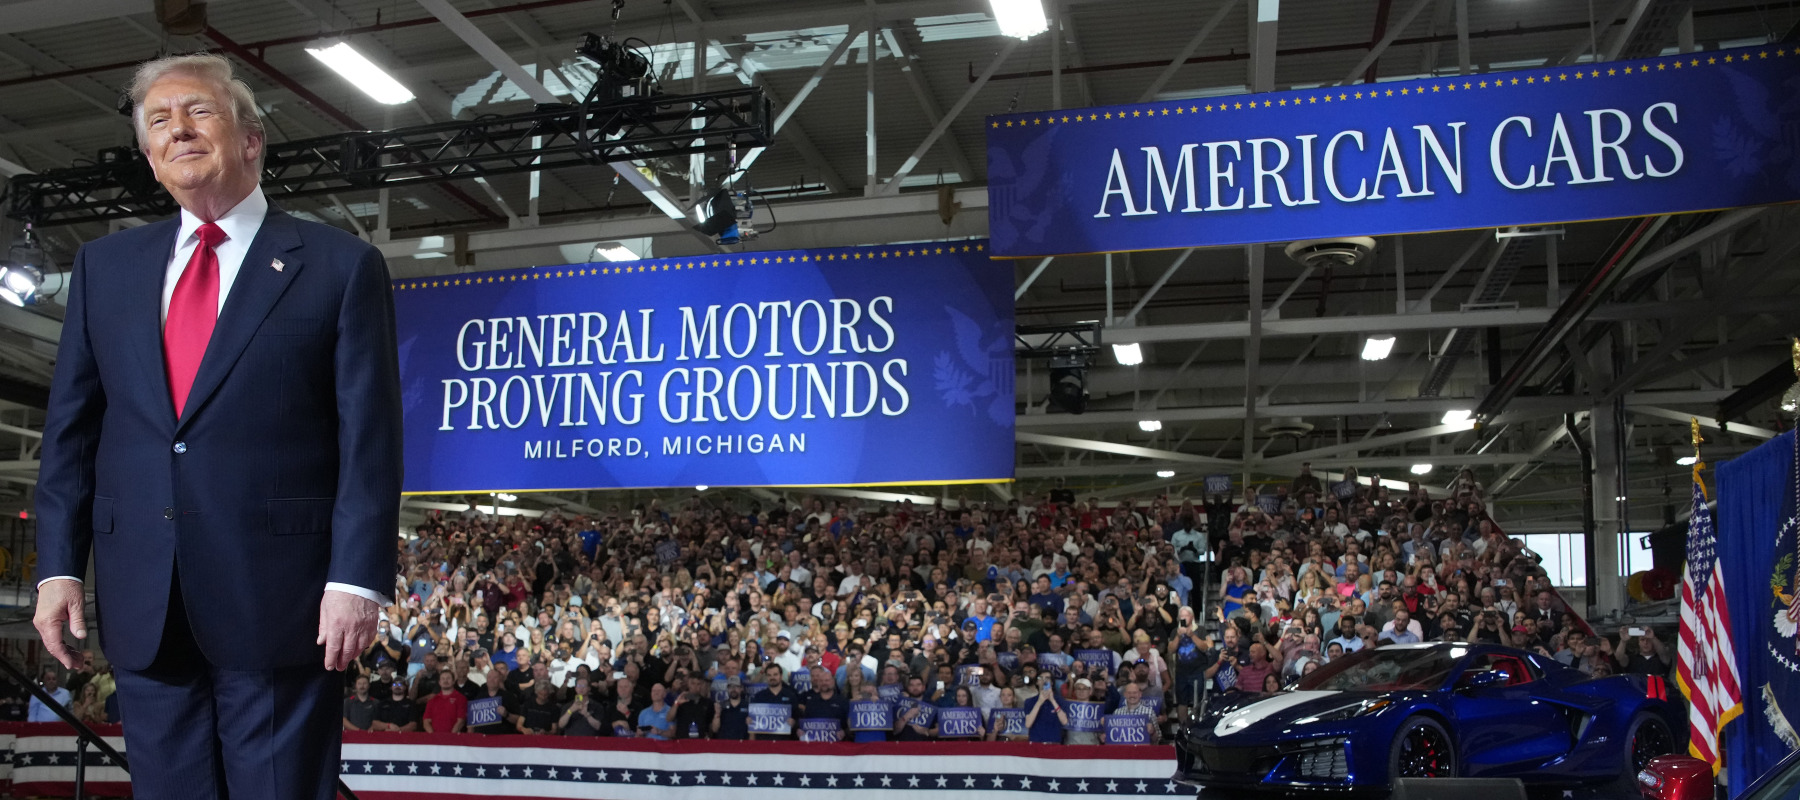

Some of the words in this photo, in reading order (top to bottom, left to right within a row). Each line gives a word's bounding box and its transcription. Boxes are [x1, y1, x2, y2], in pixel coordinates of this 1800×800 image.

[1093, 121, 1467, 218] AMERICAN
[1490, 102, 1684, 190] CARS
[456, 308, 665, 371] GENERAL
[675, 295, 895, 361] MOTORS
[438, 361, 646, 431] PROVING
[657, 358, 910, 425] GROUNDS
[524, 437, 650, 459] MILFORD,
[662, 432, 807, 456] MICHIGAN
[1076, 653, 1110, 661] AMERICAN
[471, 699, 499, 712] AMERICAN
[853, 702, 889, 712] AMERICAN
[1070, 702, 1100, 720] JOBS
[471, 707, 497, 725] JOBS
[754, 715, 785, 730] JOBS
[856, 711, 887, 728] JOBS
[942, 710, 979, 720] AMERICAN
[1107, 718, 1147, 727] AMERICAN
[803, 721, 837, 731] AMERICAN
[943, 719, 978, 735] CARS
[804, 730, 837, 743] CARS
[1110, 727, 1145, 743] CARS
